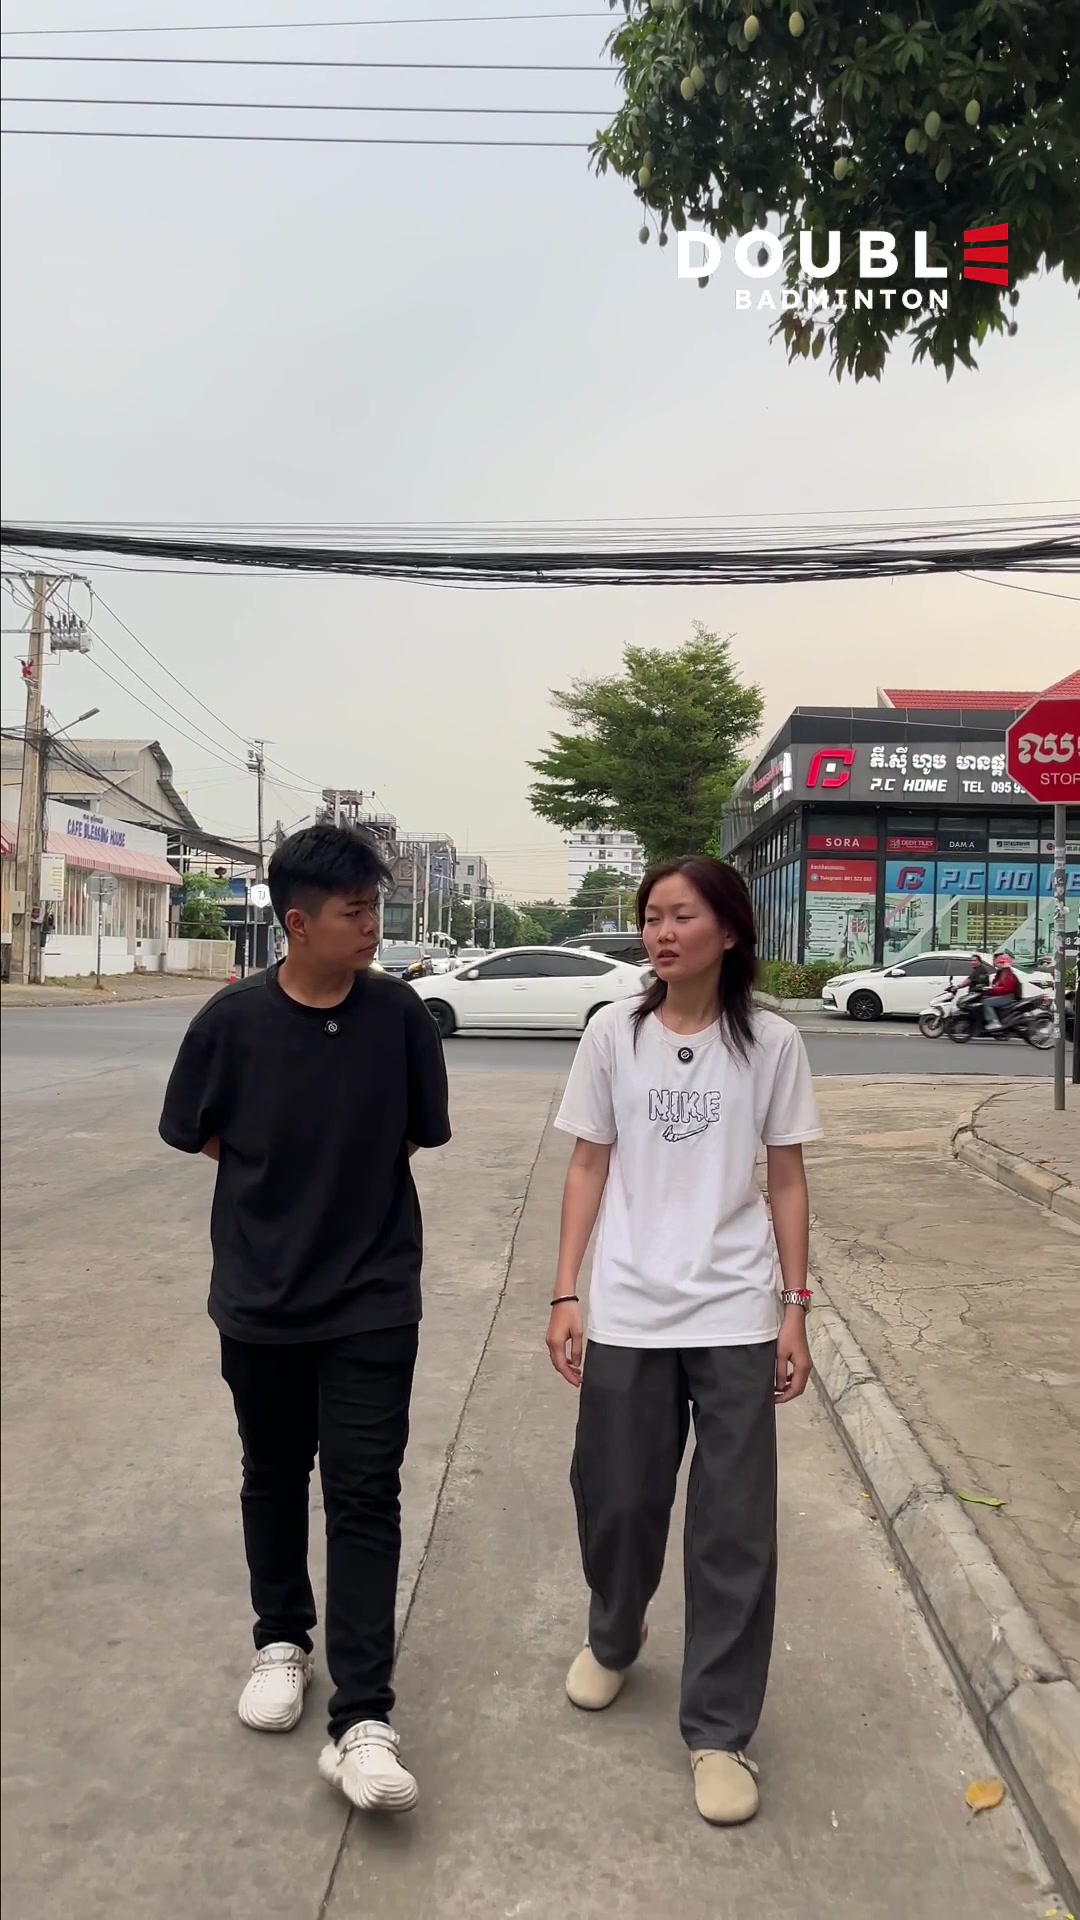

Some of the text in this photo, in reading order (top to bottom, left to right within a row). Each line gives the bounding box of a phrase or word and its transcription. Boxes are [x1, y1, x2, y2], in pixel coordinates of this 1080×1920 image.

[1018, 732, 1080, 764] ឈ
[870, 778, 948, 792] P.C HOME
[962, 780, 985, 793] TEL
[991, 781, 1012, 793] 095
[67, 818, 83, 836] CAFE
[825, 837, 860, 847] SORA
[648, 1089, 721, 1124] NIKE
